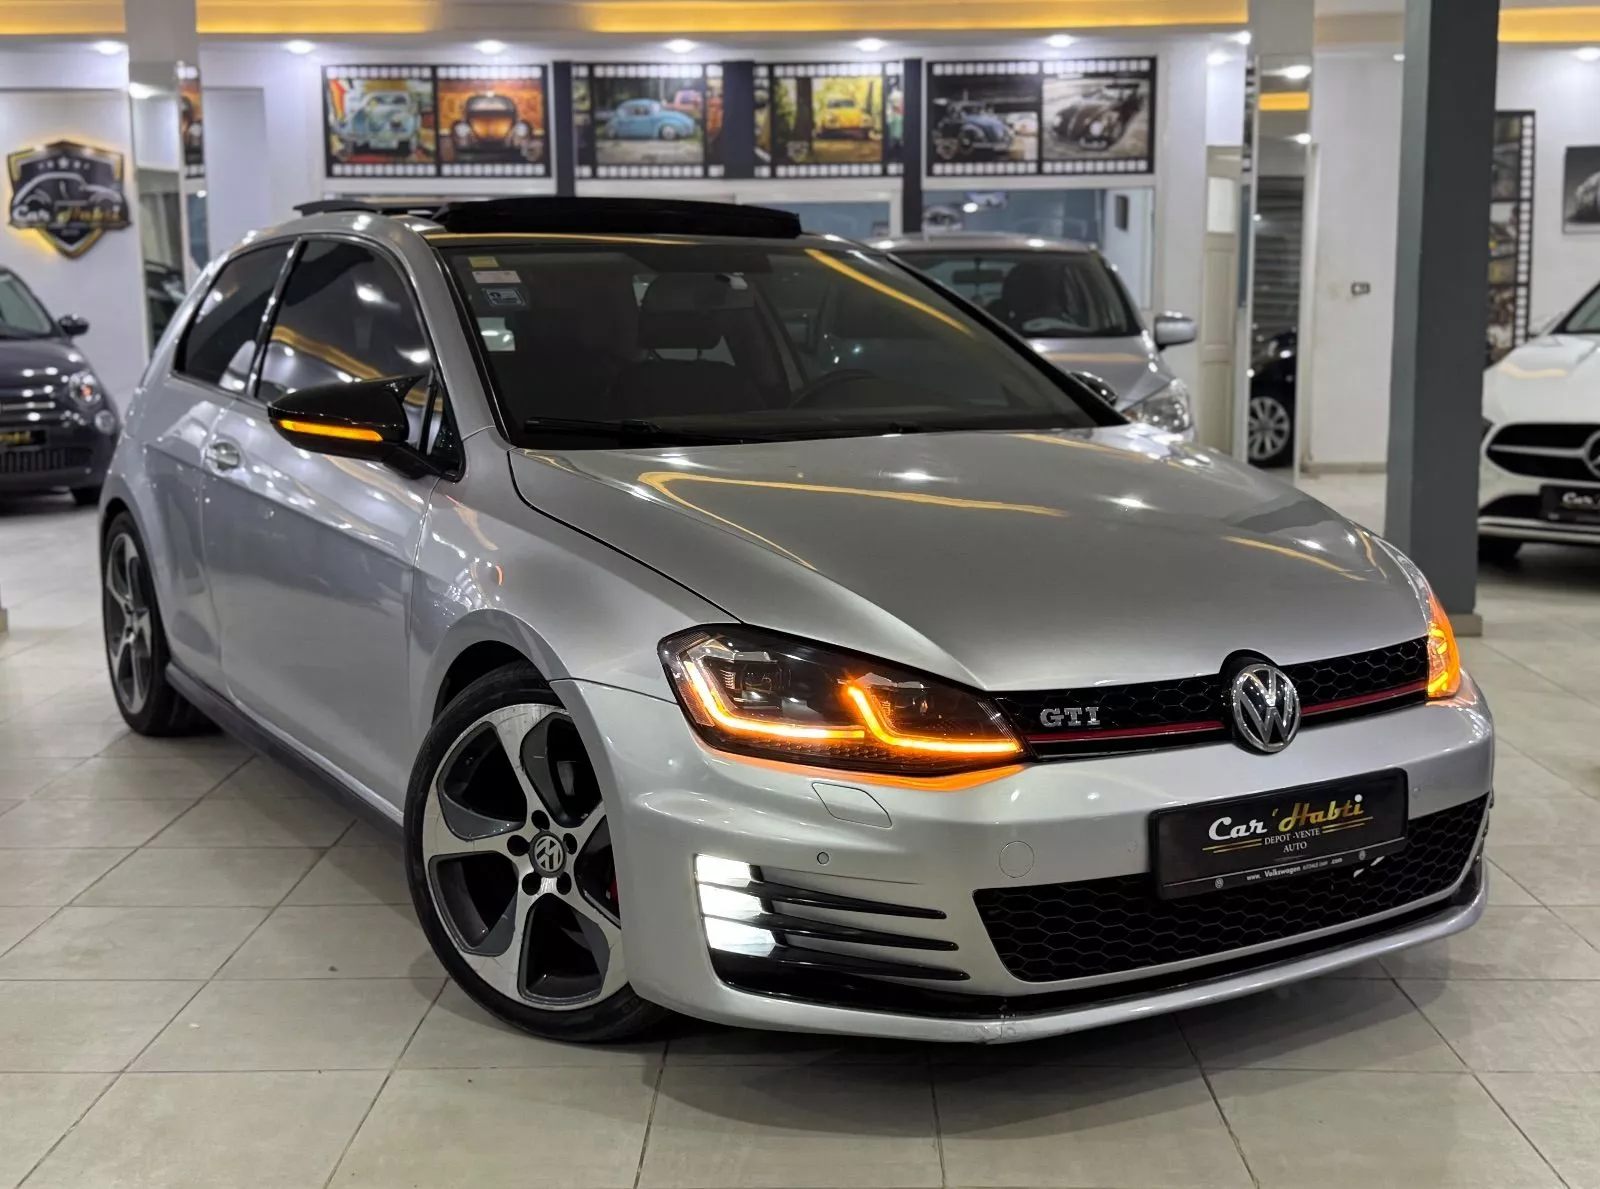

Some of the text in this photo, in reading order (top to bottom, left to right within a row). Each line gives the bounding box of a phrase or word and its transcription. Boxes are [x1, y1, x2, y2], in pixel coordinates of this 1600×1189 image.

[1039, 706, 1101, 728] GTI
[1208, 816, 1268, 841] Car
[1264, 833, 1291, 846] DEPOT
[1282, 841, 1308, 853] AUTO
[1264, 865, 1301, 879] Volkswagen
